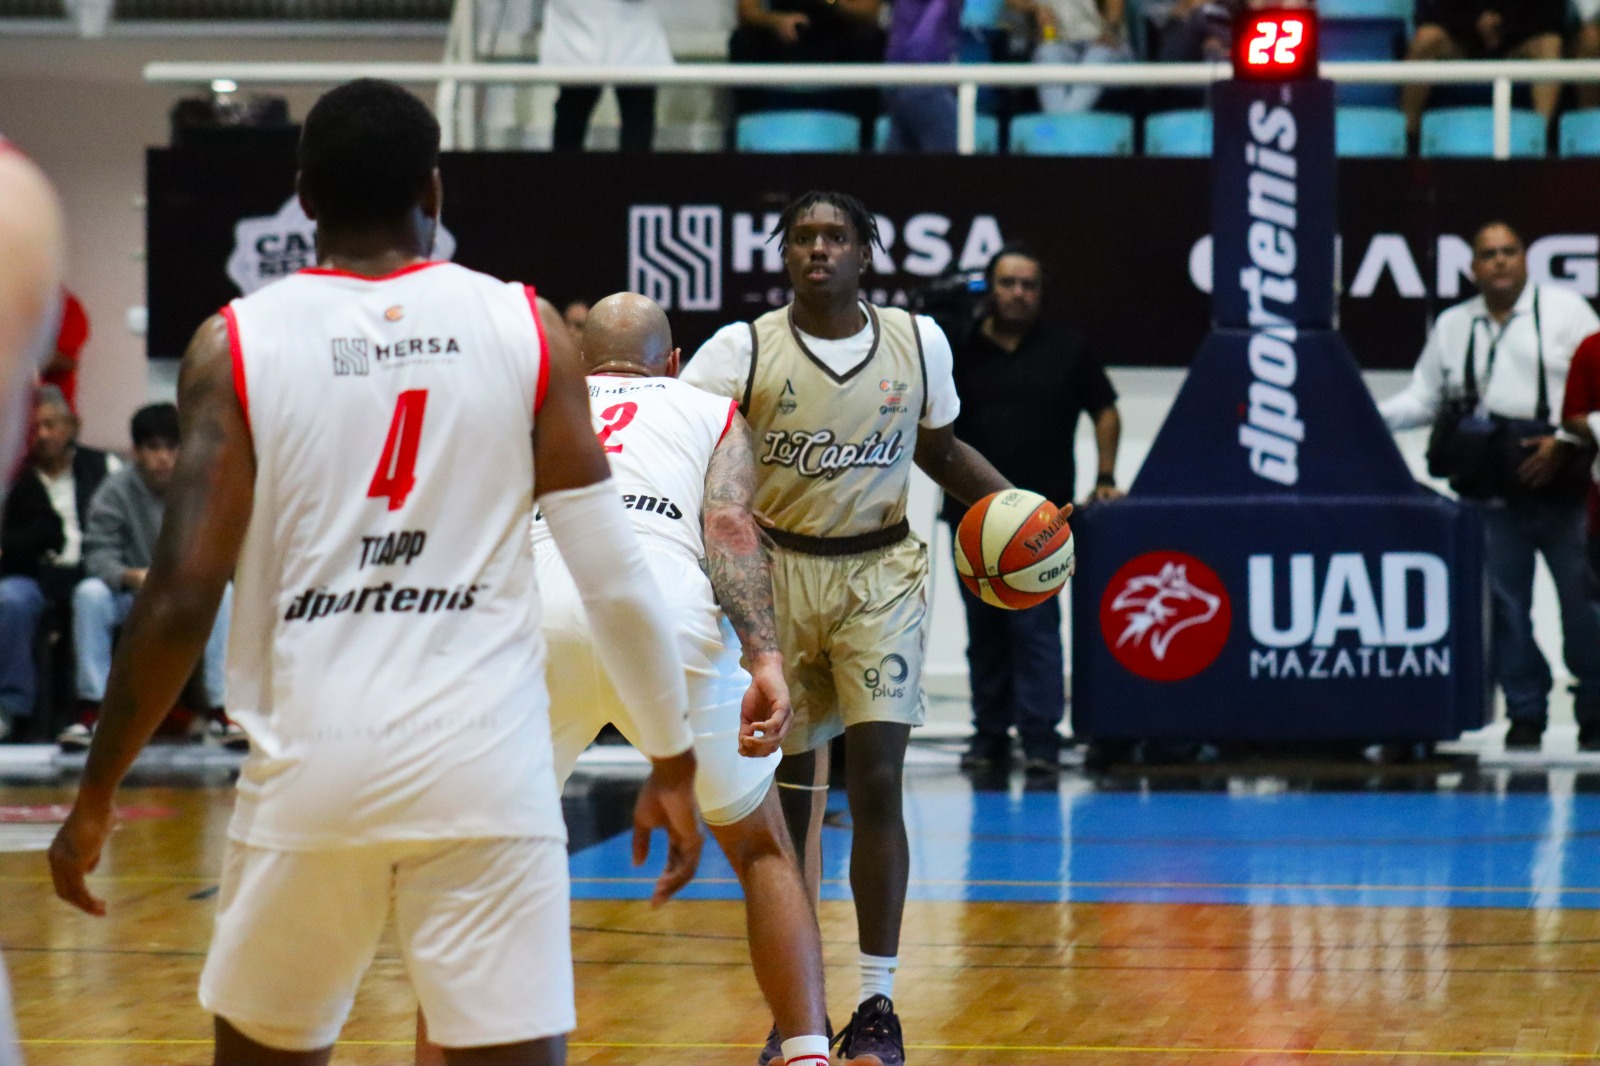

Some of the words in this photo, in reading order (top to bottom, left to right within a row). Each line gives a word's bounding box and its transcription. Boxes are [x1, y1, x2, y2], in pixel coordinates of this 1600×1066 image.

[1248, 20, 1304, 65] 22
[731, 212, 1004, 276] HRSA
[1239, 100, 1305, 487] dportenis
[375, 337, 461, 362] HERSA
[366, 388, 429, 512] 4
[596, 401, 639, 454] 2
[792, 428, 904, 480] Captal
[284, 582, 478, 622] dportenis
[1247, 552, 1450, 648] UAD
[872, 684, 904, 702] plus
